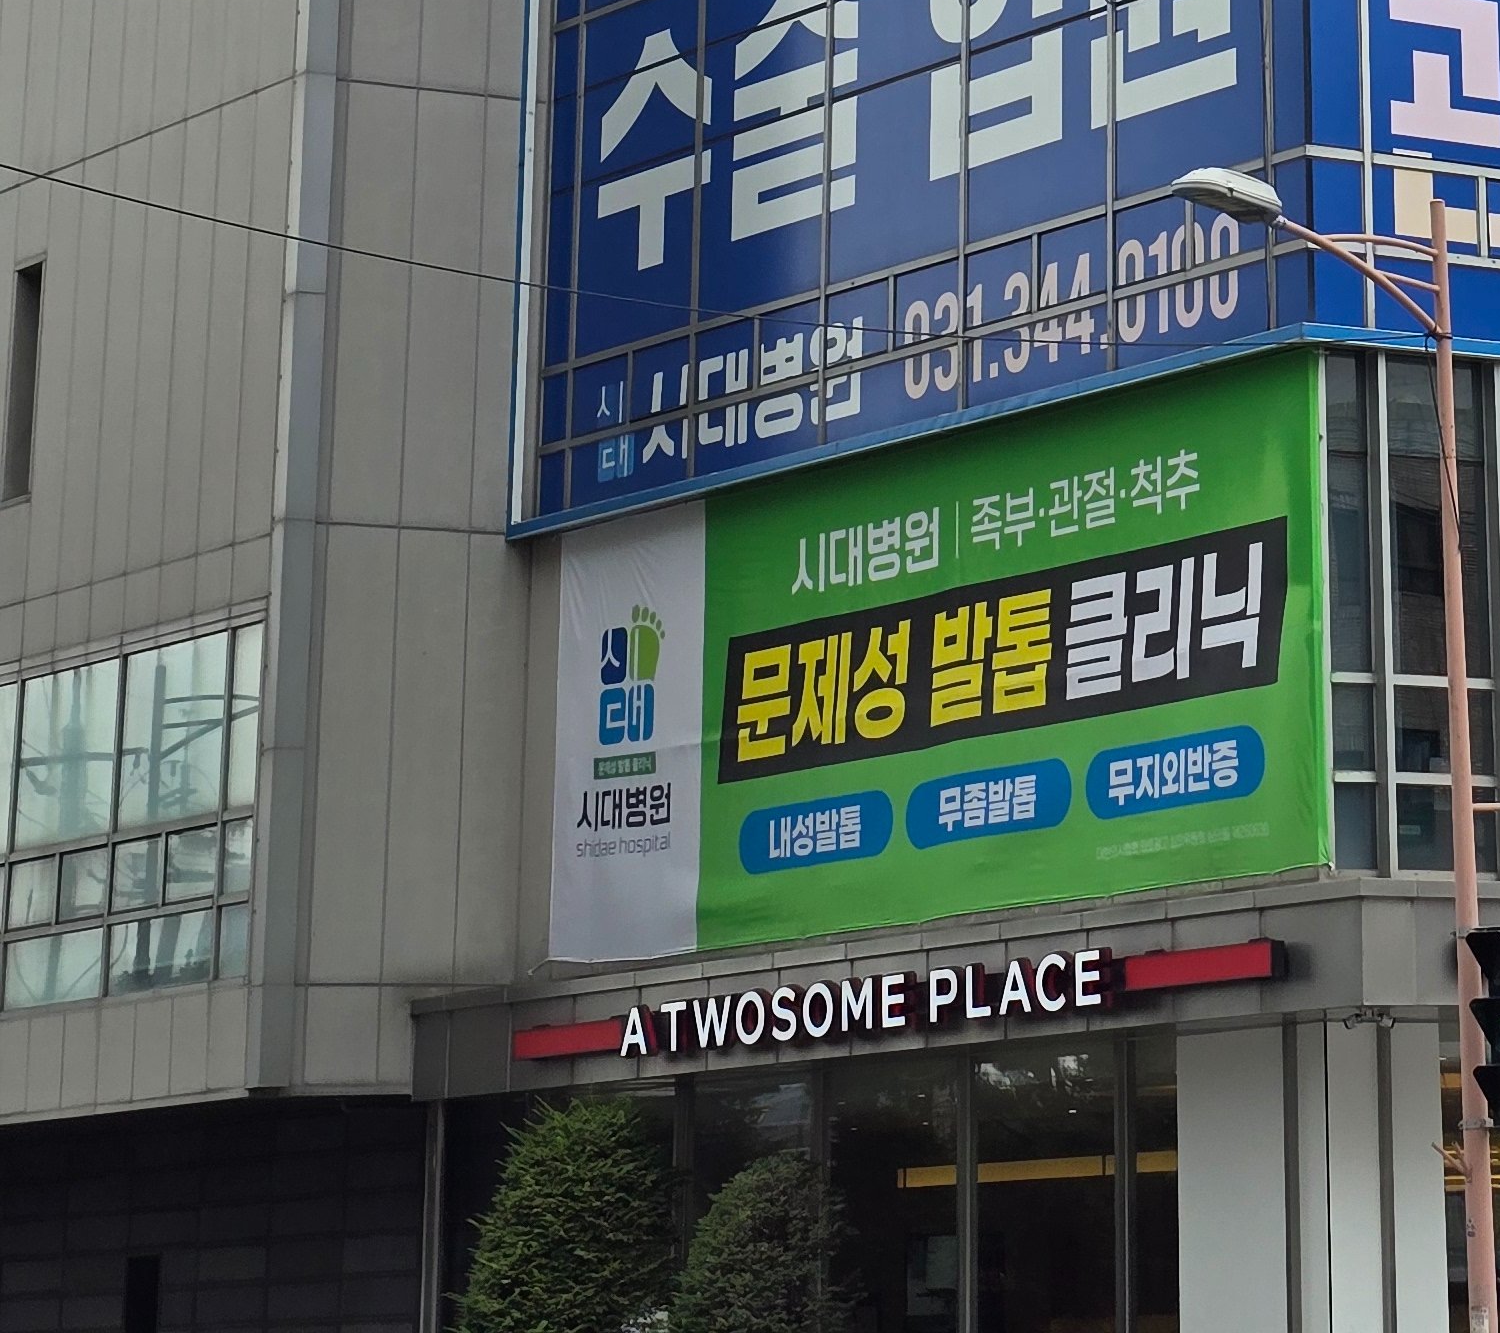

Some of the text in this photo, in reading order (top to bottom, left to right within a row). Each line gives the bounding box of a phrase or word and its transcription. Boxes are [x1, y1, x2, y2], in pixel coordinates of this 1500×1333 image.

[642, 317, 863, 465] 시대병원
[903, 218, 1240, 400] 031.344.0100
[791, 448, 1201, 596] 시대병원 족부·관절·척추
[736, 541, 1262, 763] 문제성 발톱 클리닉
[577, 782, 671, 831] 시대병원
[938, 774, 1037, 833] 무좀발톱
[1107, 744, 1240, 807] 무지외반증
[576, 831, 671, 858] shidae hospital
[769, 804, 863, 860] 내성발톱
[620, 949, 1103, 1058] A TWOSOME PLACE
